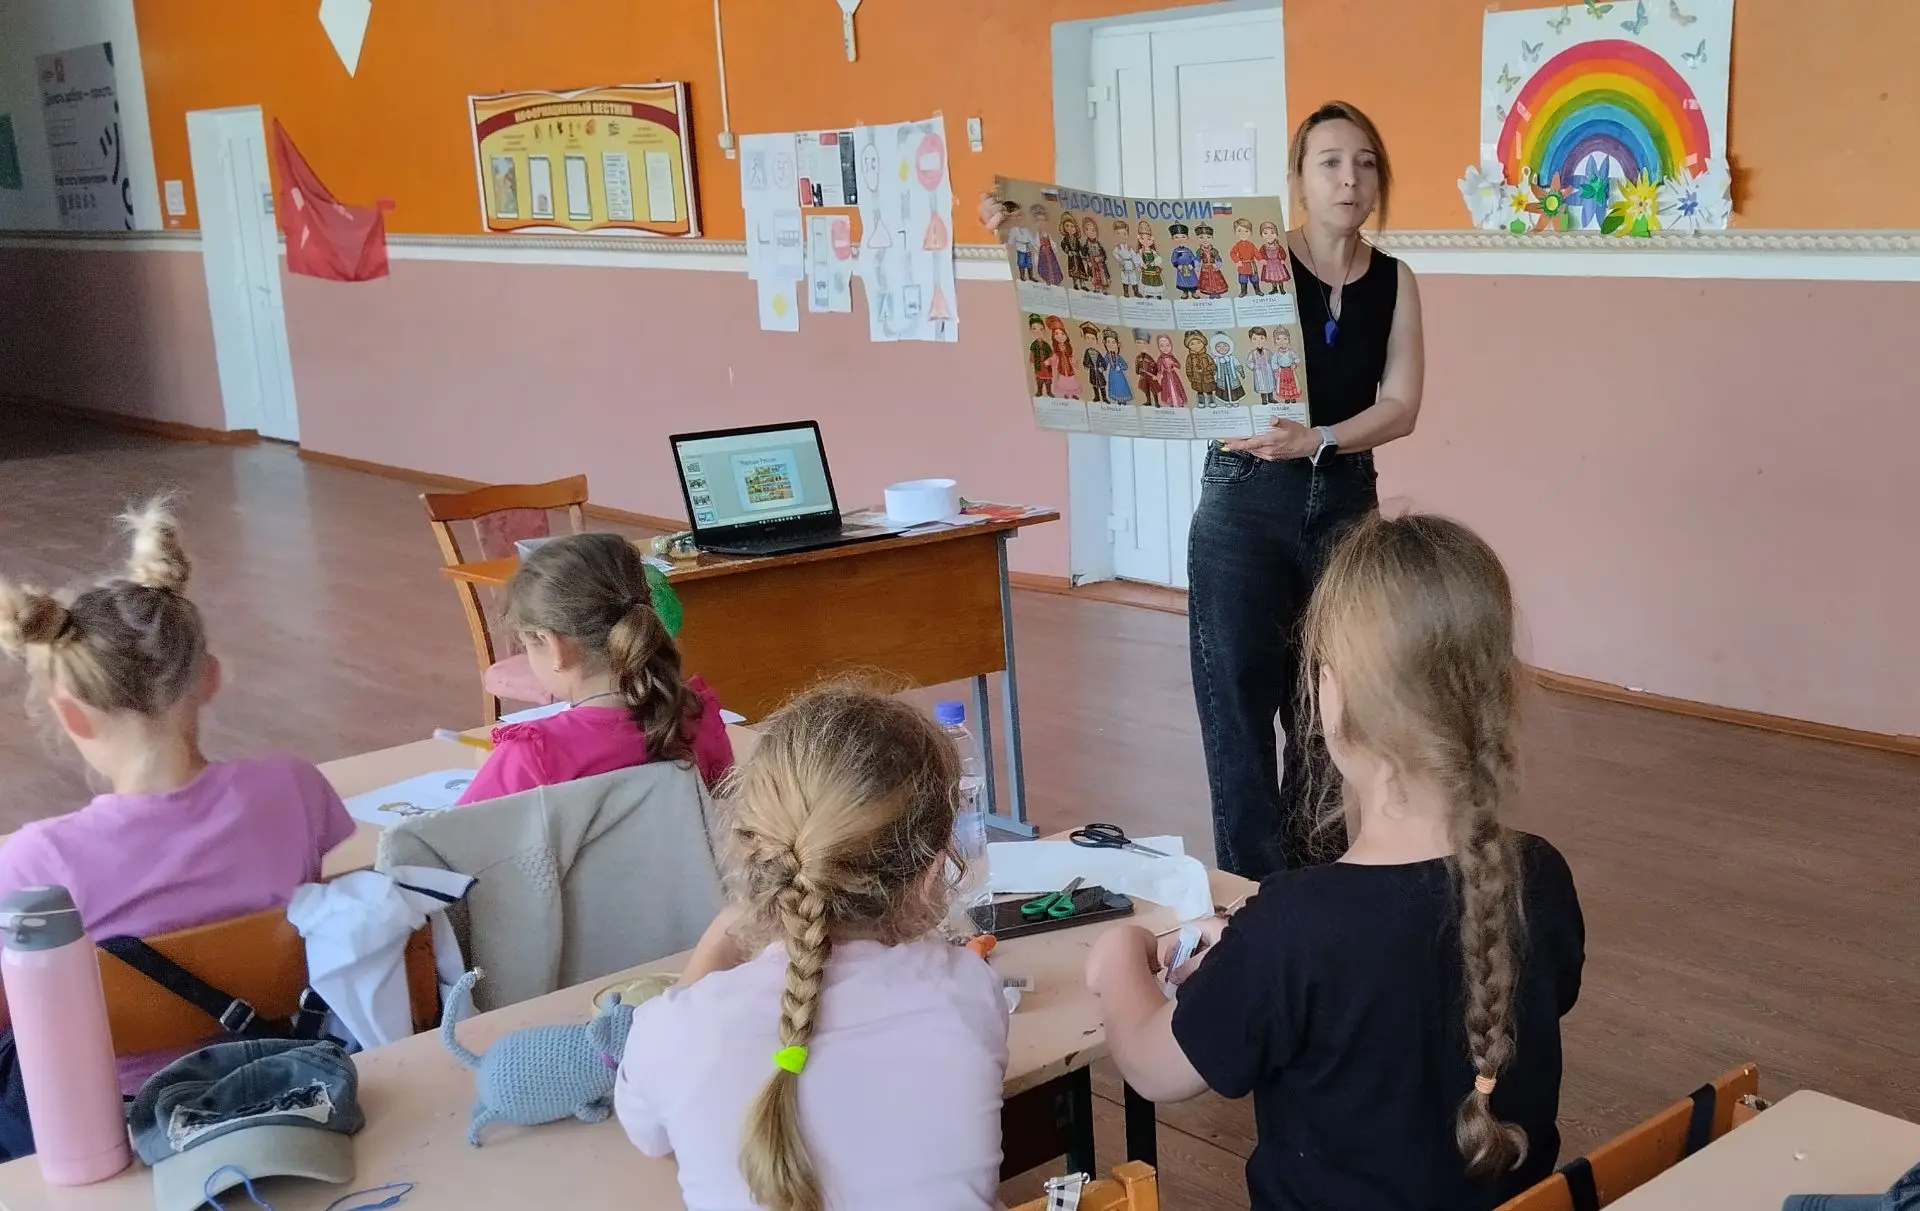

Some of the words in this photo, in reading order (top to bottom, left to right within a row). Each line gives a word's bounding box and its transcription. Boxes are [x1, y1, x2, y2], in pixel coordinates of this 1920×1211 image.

[1204, 150, 1211, 163] 5
[1213, 147, 1252, 162] КЛАСС
[1059, 190, 1128, 219] НАРОДЫ
[1134, 200, 1214, 220] РОССИИ
